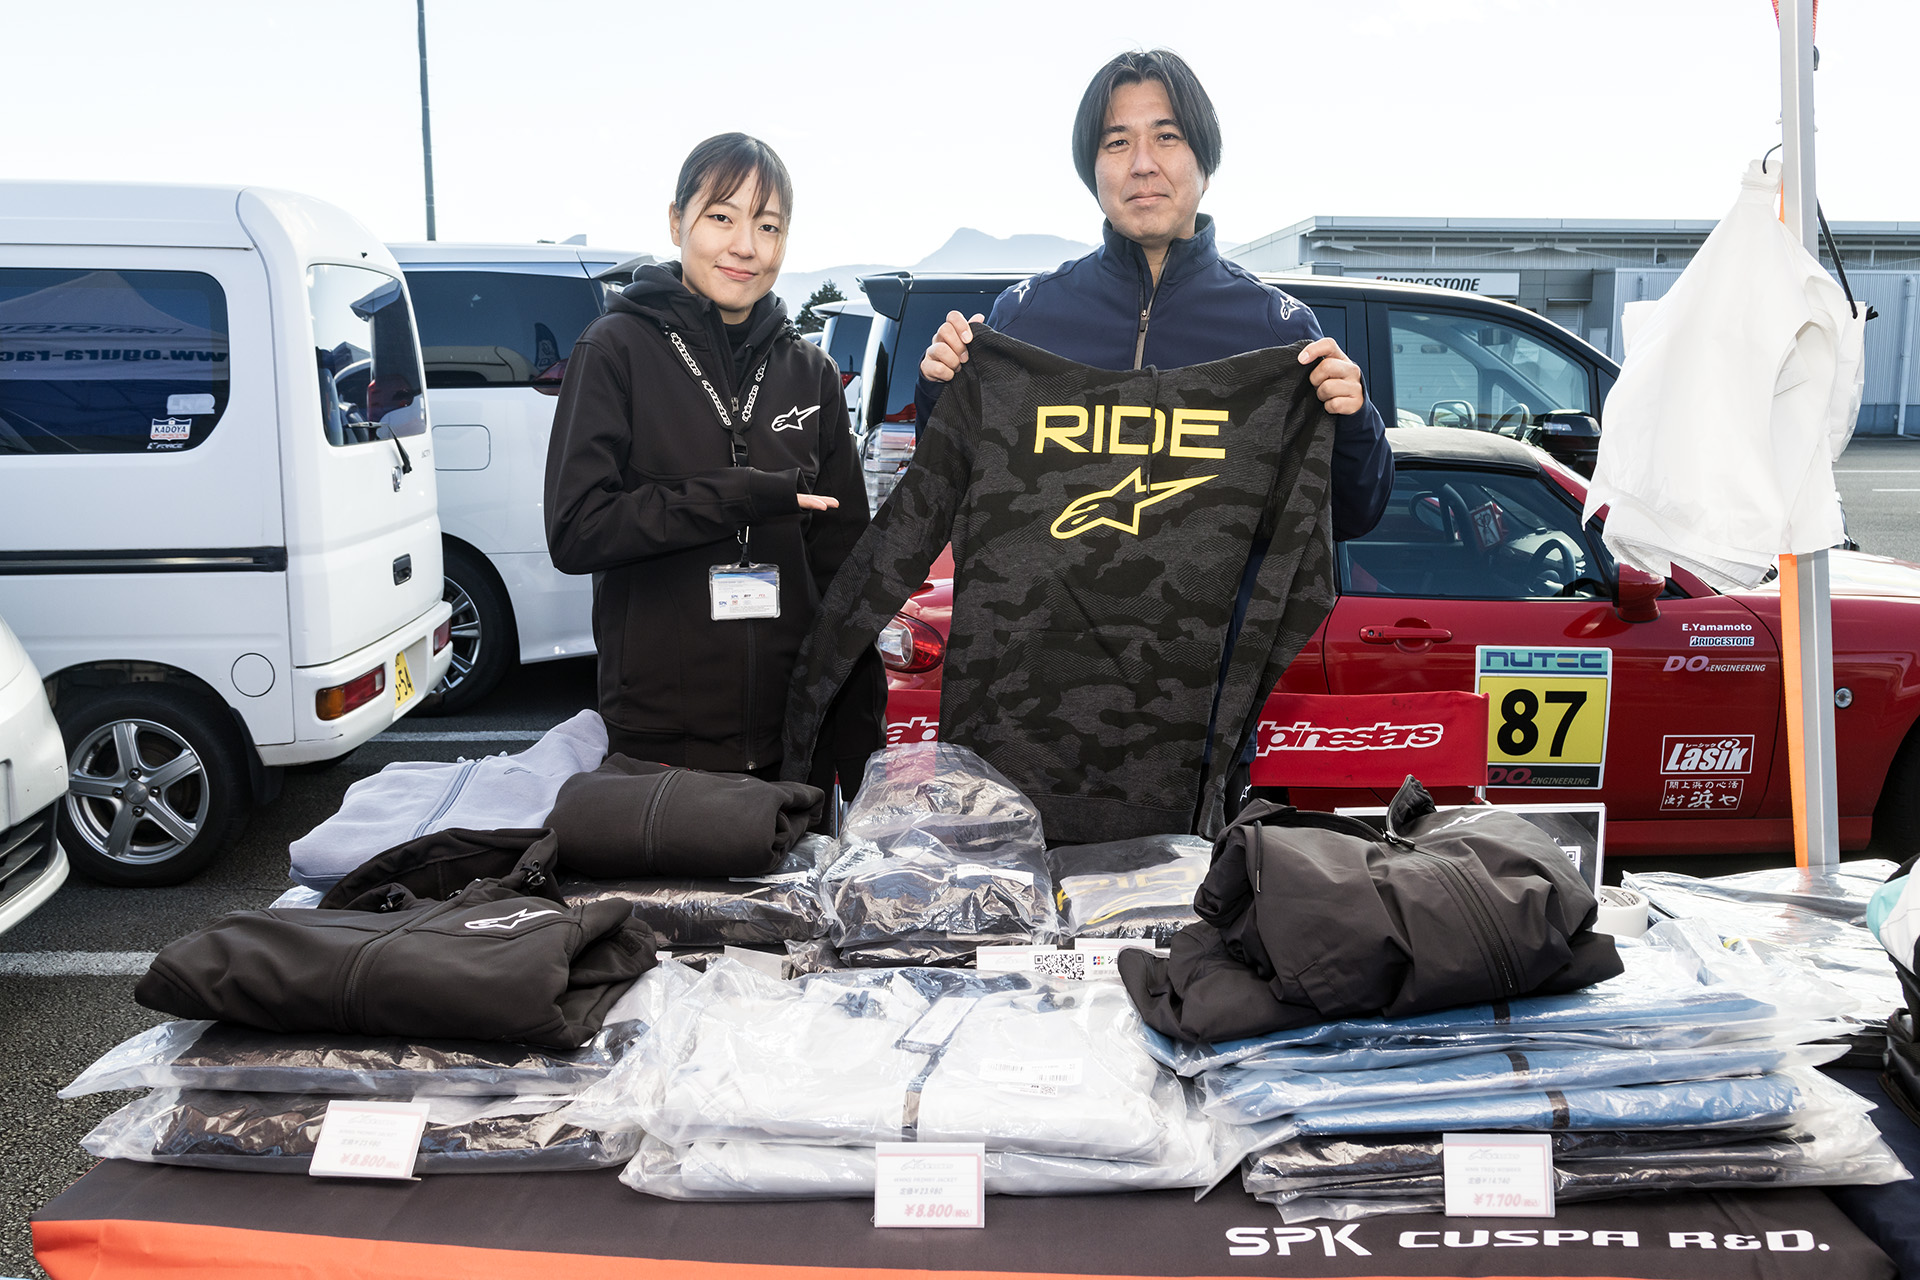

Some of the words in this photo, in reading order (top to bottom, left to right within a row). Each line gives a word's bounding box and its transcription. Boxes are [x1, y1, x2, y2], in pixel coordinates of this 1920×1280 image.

[1034, 405, 1229, 459] RIDE
[1682, 623, 1753, 631] E.Yamamoto
[1690, 635, 1754, 646] BRIDGESTONE
[1486, 652, 1602, 668] NUTEC
[1497, 689, 1587, 757] 87
[1665, 739, 1749, 771] Lasik
[1225, 1223, 1372, 1256] SPK
[1399, 1230, 1639, 1248] CUSPA
[1668, 1230, 1830, 1251] R&D.
